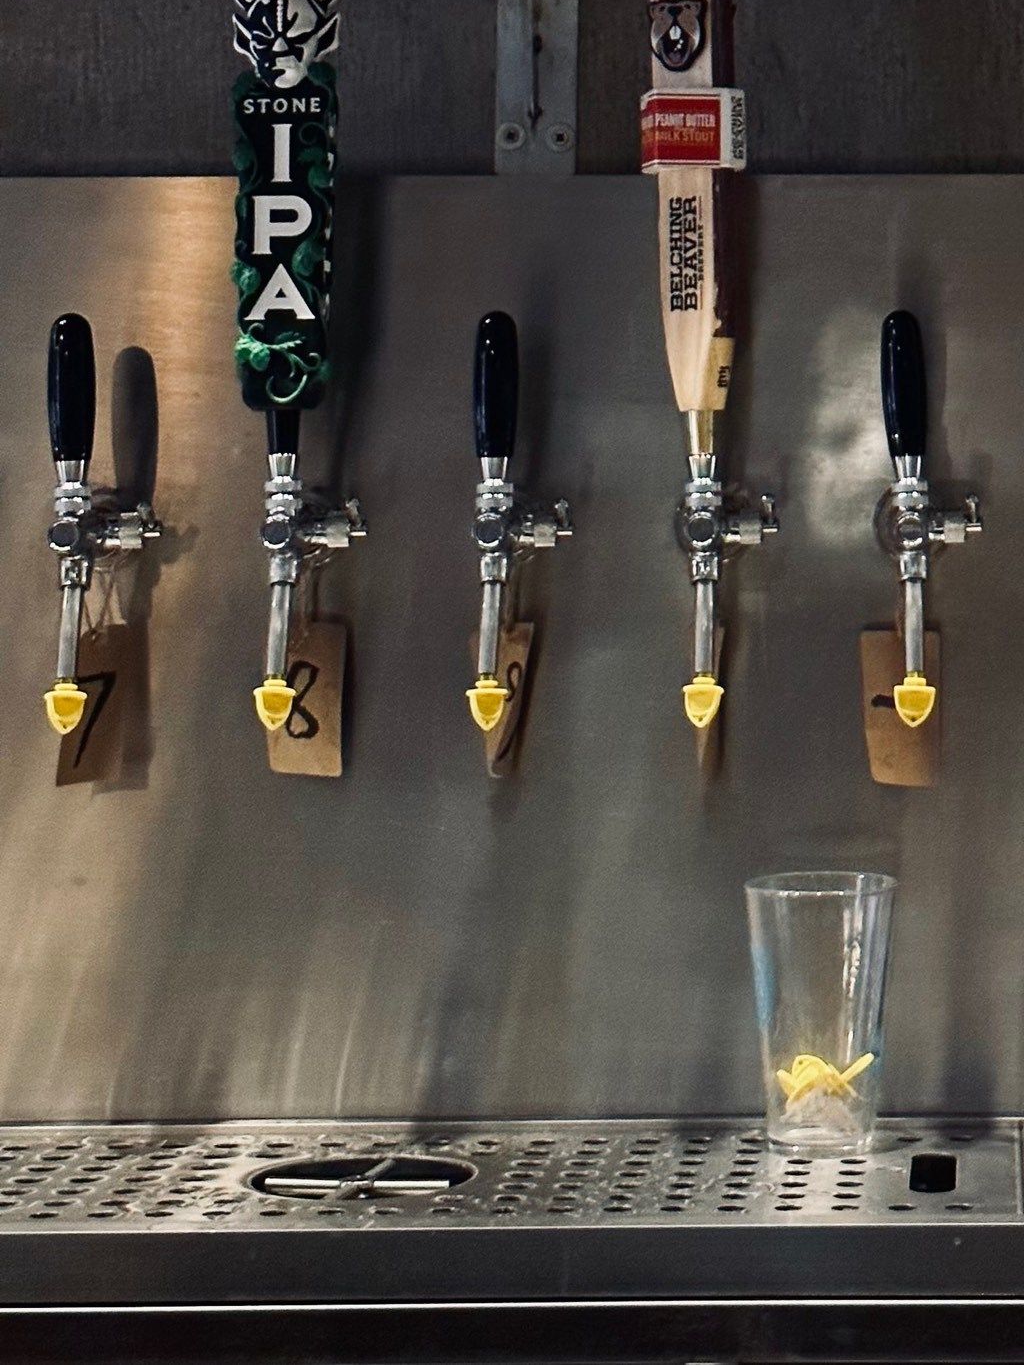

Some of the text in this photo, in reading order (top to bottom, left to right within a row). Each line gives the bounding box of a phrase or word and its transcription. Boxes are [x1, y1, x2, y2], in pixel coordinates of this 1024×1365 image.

[242, 97, 322, 114] STONE
[685, 113, 716, 127] BUTTER
[682, 130, 714, 142] STOUT
[669, 196, 683, 312] BELCHING
[682, 195, 698, 312] BEAVER
[286, 660, 320, 740] 8
